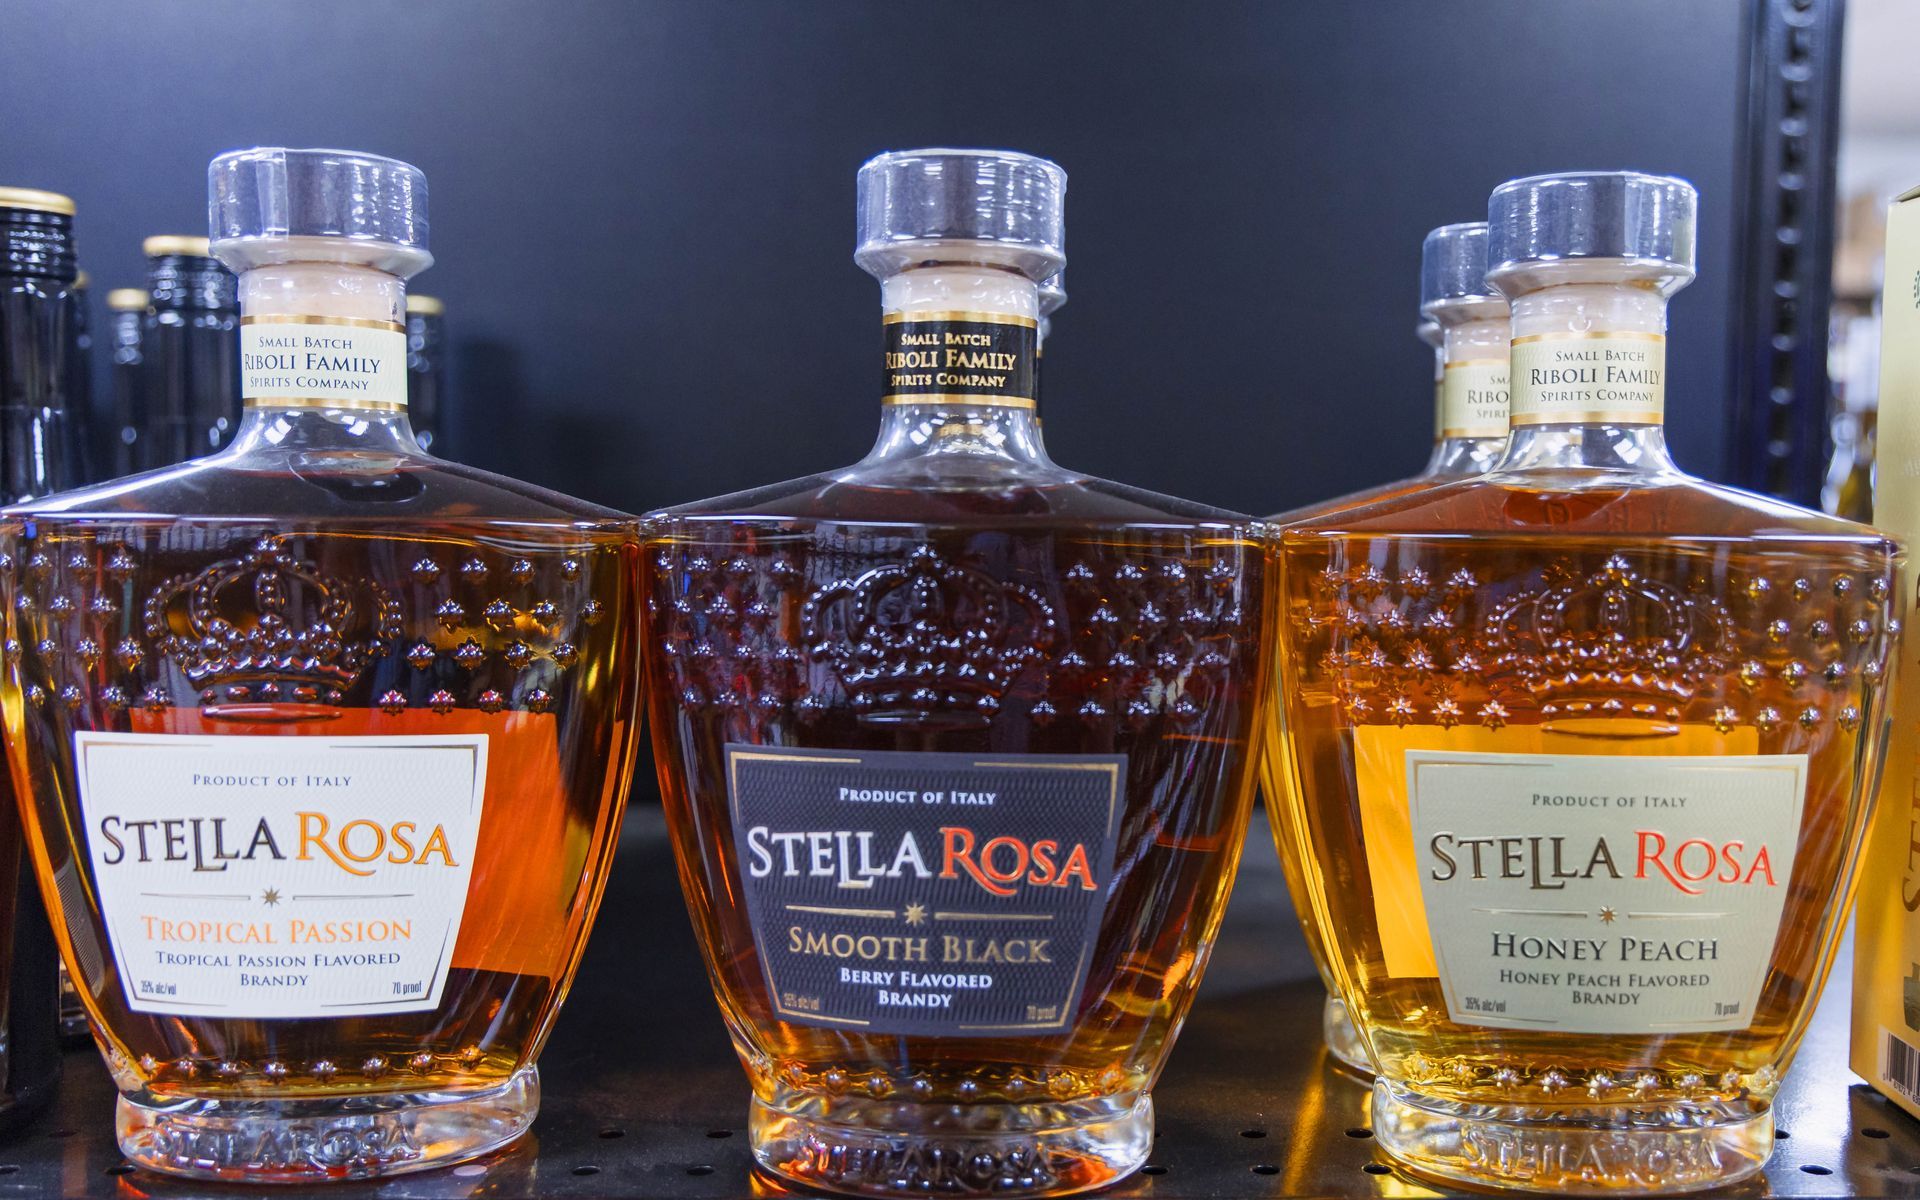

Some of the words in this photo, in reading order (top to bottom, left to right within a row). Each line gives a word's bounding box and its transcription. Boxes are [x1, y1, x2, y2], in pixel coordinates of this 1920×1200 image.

[259, 336, 298, 348] SMALL
[304, 336, 352, 350] BATCH
[901, 333, 940, 346] SMALL
[945, 332, 991, 347] BATCH
[245, 353, 296, 371] RIBOLI
[306, 352, 381, 374] FAMILY
[885, 351, 938, 370] RIBOLI
[945, 349, 1017, 371] FAMILY
[1555, 350, 1600, 362] SMALL
[1605, 350, 1645, 362] BATCH
[250, 376, 290, 388] SPIRITS
[296, 376, 369, 391] COMPANY
[891, 374, 932, 387] SPIRITS
[936, 372, 1006, 388] COMPANY
[1531, 368, 1597, 386] RIBOLI
[1607, 366, 1661, 386] FAMILY
[1467, 389, 1510, 404] RIBO
[1541, 390, 1592, 402] SPIRITS
[1596, 389, 1654, 402] COMPANY
[193, 774, 269, 787] PRODUCT
[278, 775, 298, 786] OF
[307, 775, 352, 787] ITALY
[839, 787, 916, 804] PRODUCT
[922, 791, 944, 804] OF
[951, 791, 996, 805] ITALY
[1532, 793, 1609, 808] PRODUCT
[1616, 797, 1637, 808] OF
[1644, 796, 1687, 809] ITALY
[100, 815, 287, 872] STELLA
[294, 811, 460, 877] ROSA
[747, 826, 932, 889] STELLA
[938, 826, 1098, 896] ROSA
[1430, 831, 1623, 890] STELLA
[1634, 830, 1778, 895] ROSA
[140, 916, 278, 945] TROPICAL
[289, 919, 412, 945] PASSION
[788, 927, 928, 962] SMOOTH
[942, 935, 1052, 964] BLACK
[1491, 931, 1607, 961] HONEY
[1620, 936, 1718, 961] PEACH
[155, 951, 232, 967] TROPICAL
[238, 954, 306, 968] PASSION
[313, 952, 401, 967] FLAVORED
[240, 973, 308, 987] BRANDY
[840, 967, 894, 985] BERRY
[900, 971, 993, 989] FLAVORED
[1500, 970, 1560, 986] HONEY
[1567, 972, 1621, 987] PEACH
[1629, 974, 1710, 988] FLAVORED
[155, 981, 176, 995] alc/vol
[392, 981, 401, 994] 70
[403, 980, 422, 995] proof
[878, 990, 952, 1008] BRANDY
[1572, 992, 1641, 1006] BRANDY
